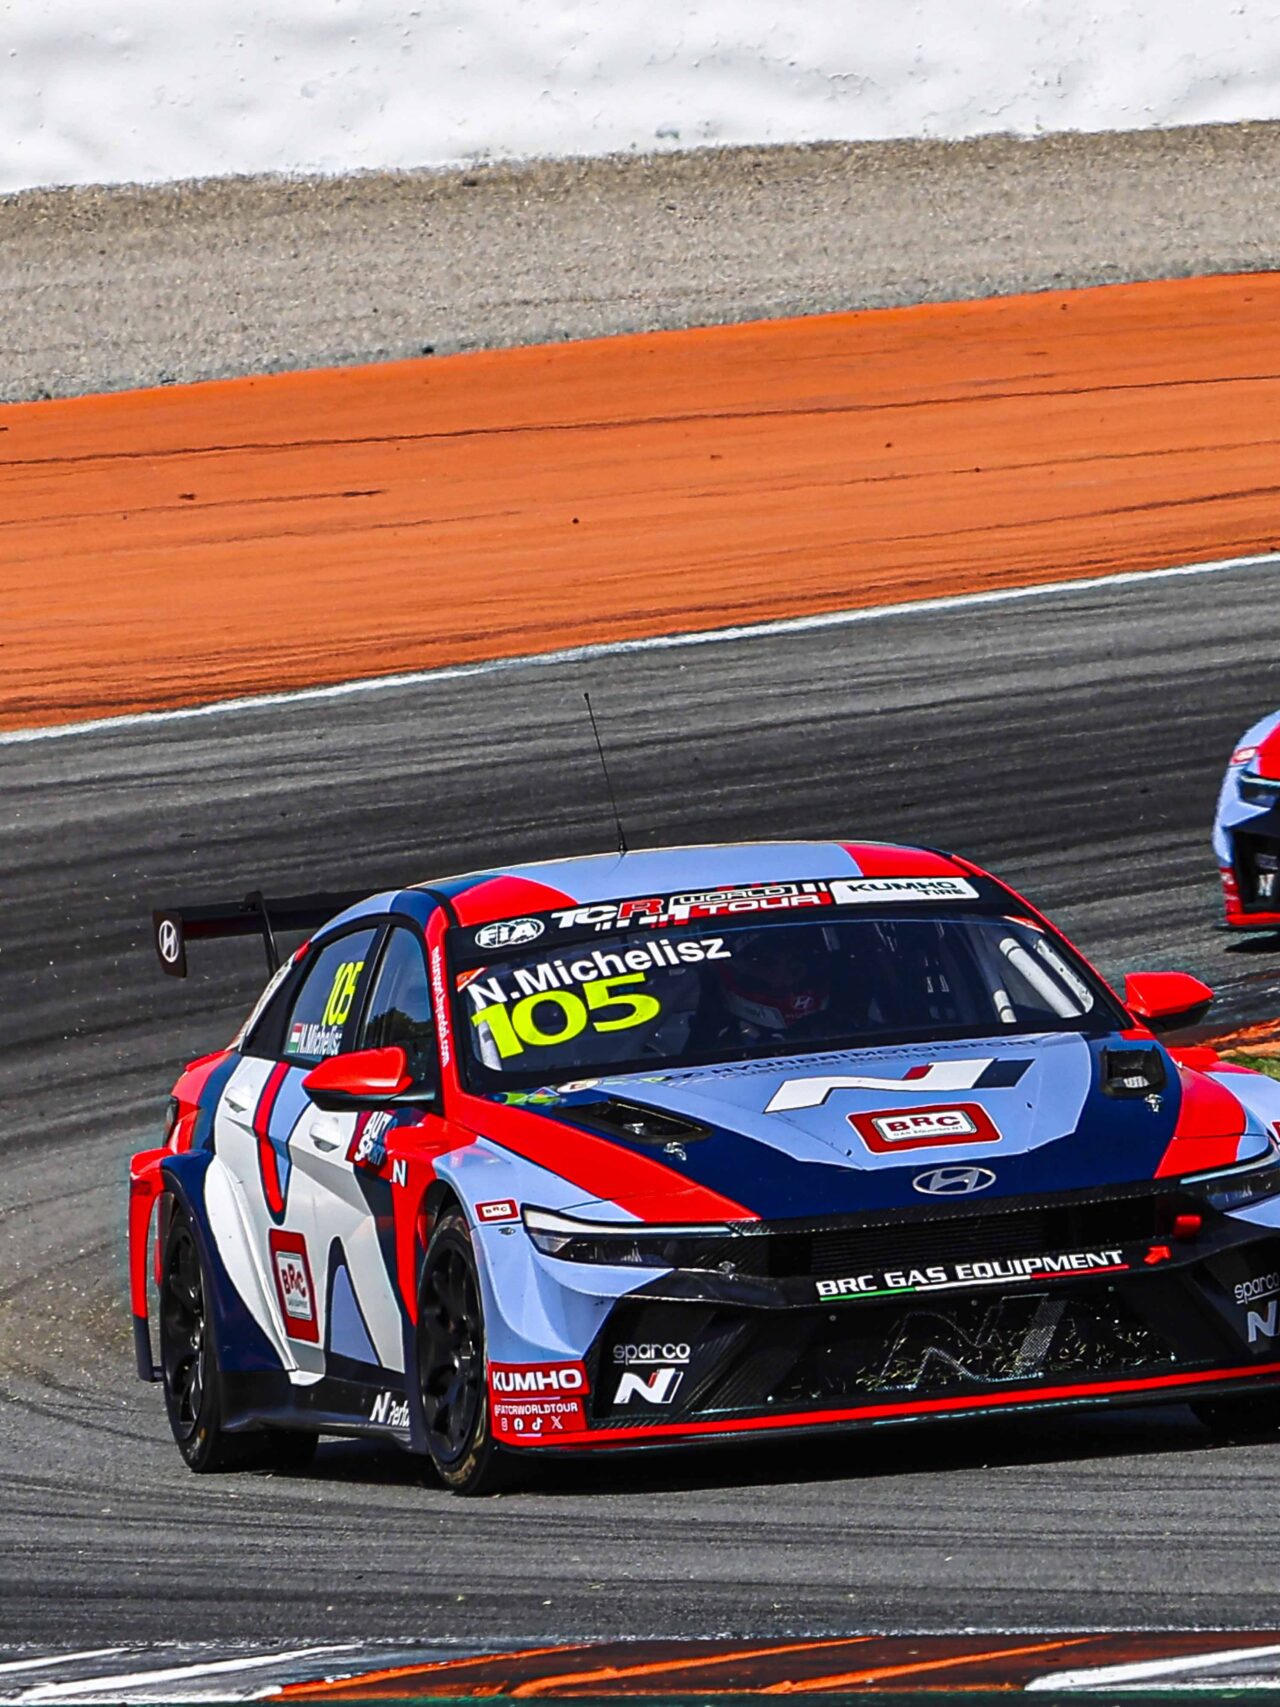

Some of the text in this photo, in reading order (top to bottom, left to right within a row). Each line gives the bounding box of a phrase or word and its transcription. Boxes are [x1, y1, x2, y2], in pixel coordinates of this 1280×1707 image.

[699, 893, 823, 915] TOUR
[847, 880, 958, 895] KUMHO
[915, 887, 968, 897] TIRE
[550, 884, 786, 930] TCR WORLD
[466, 937, 732, 1009] N.Michelisz
[321, 961, 364, 1026] 105
[470, 972, 661, 1059] 105
[886, 1105, 961, 1132] BRC
[281, 1263, 307, 1298] BRC
[816, 1250, 1124, 1297] BRC GAS EQUIPMENT
[1234, 1271, 1280, 1305] sparco
[613, 1343, 691, 1366] sparco
[492, 1368, 583, 1392] KUMHO
